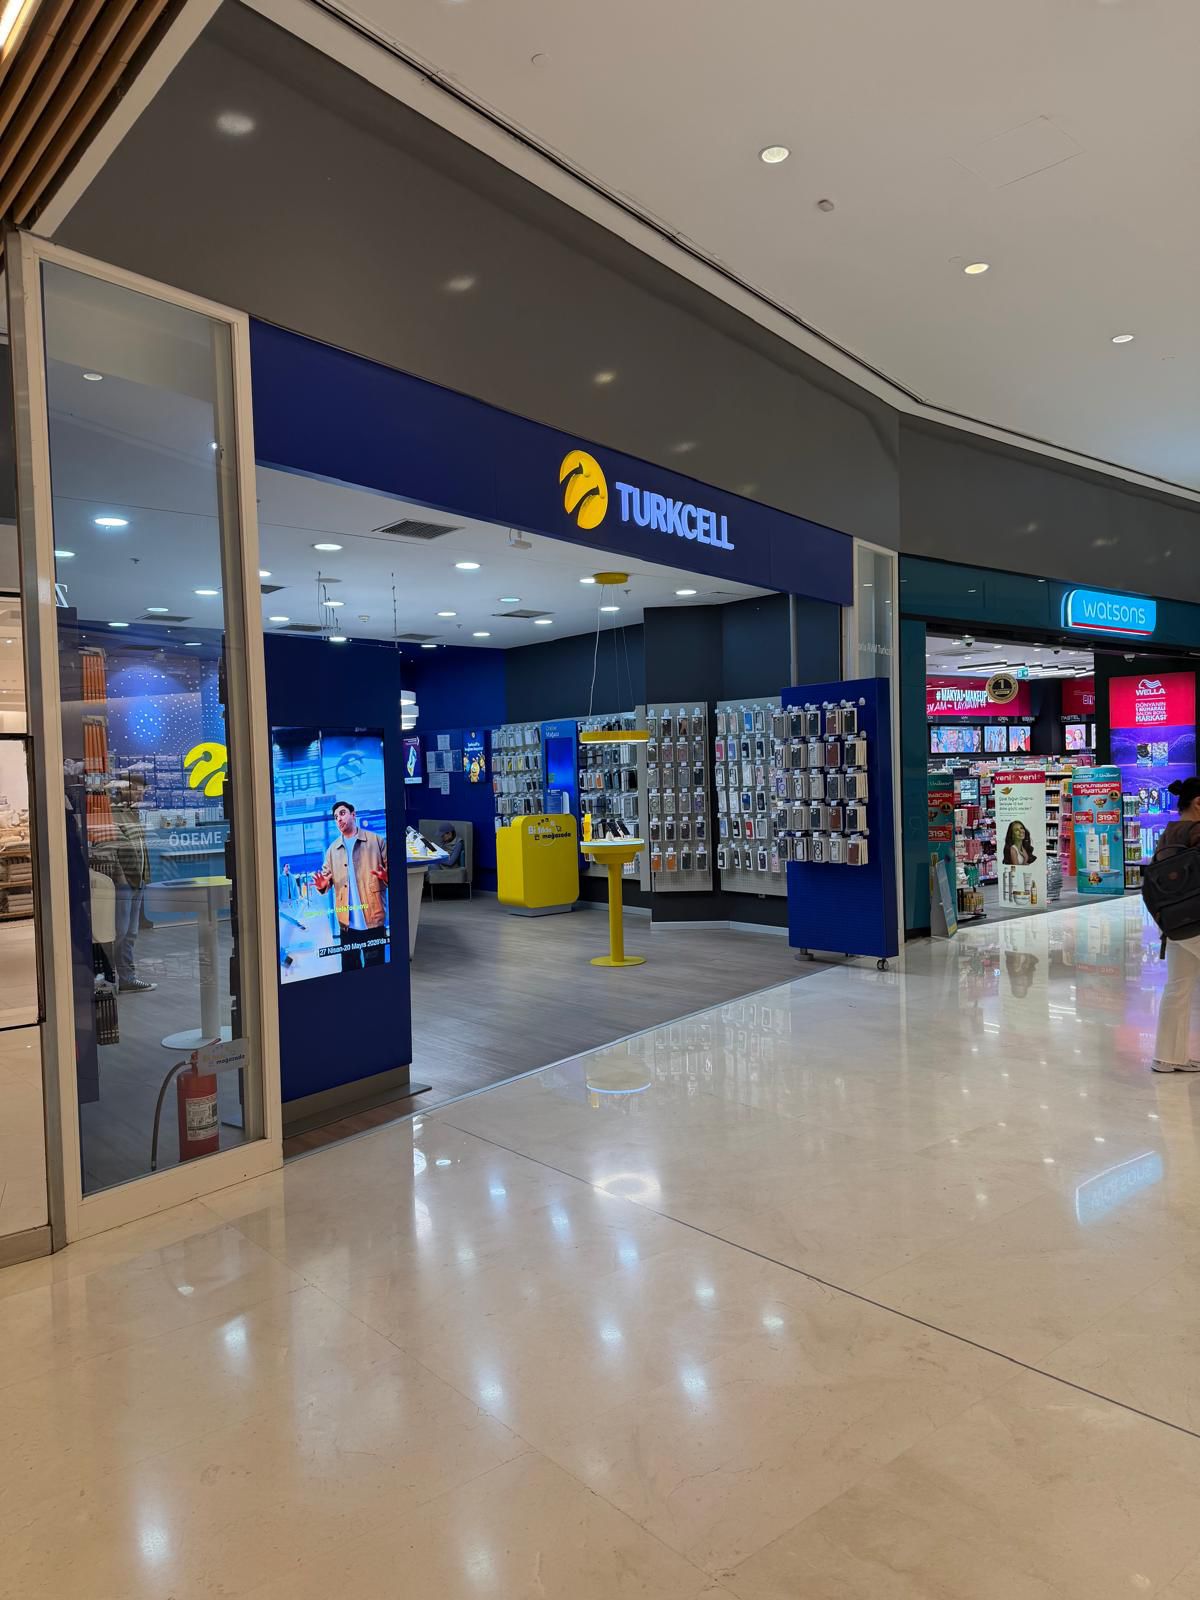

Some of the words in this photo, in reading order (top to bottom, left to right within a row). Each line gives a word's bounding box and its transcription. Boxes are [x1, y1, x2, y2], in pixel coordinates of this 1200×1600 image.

[616, 482, 734, 550] TURKCELL
[1083, 600, 1146, 625] watsons
[1136, 688, 1166, 696] WELLA
[169, 831, 222, 846] ÖDEME
[352, 942, 366, 950] Mayıs
